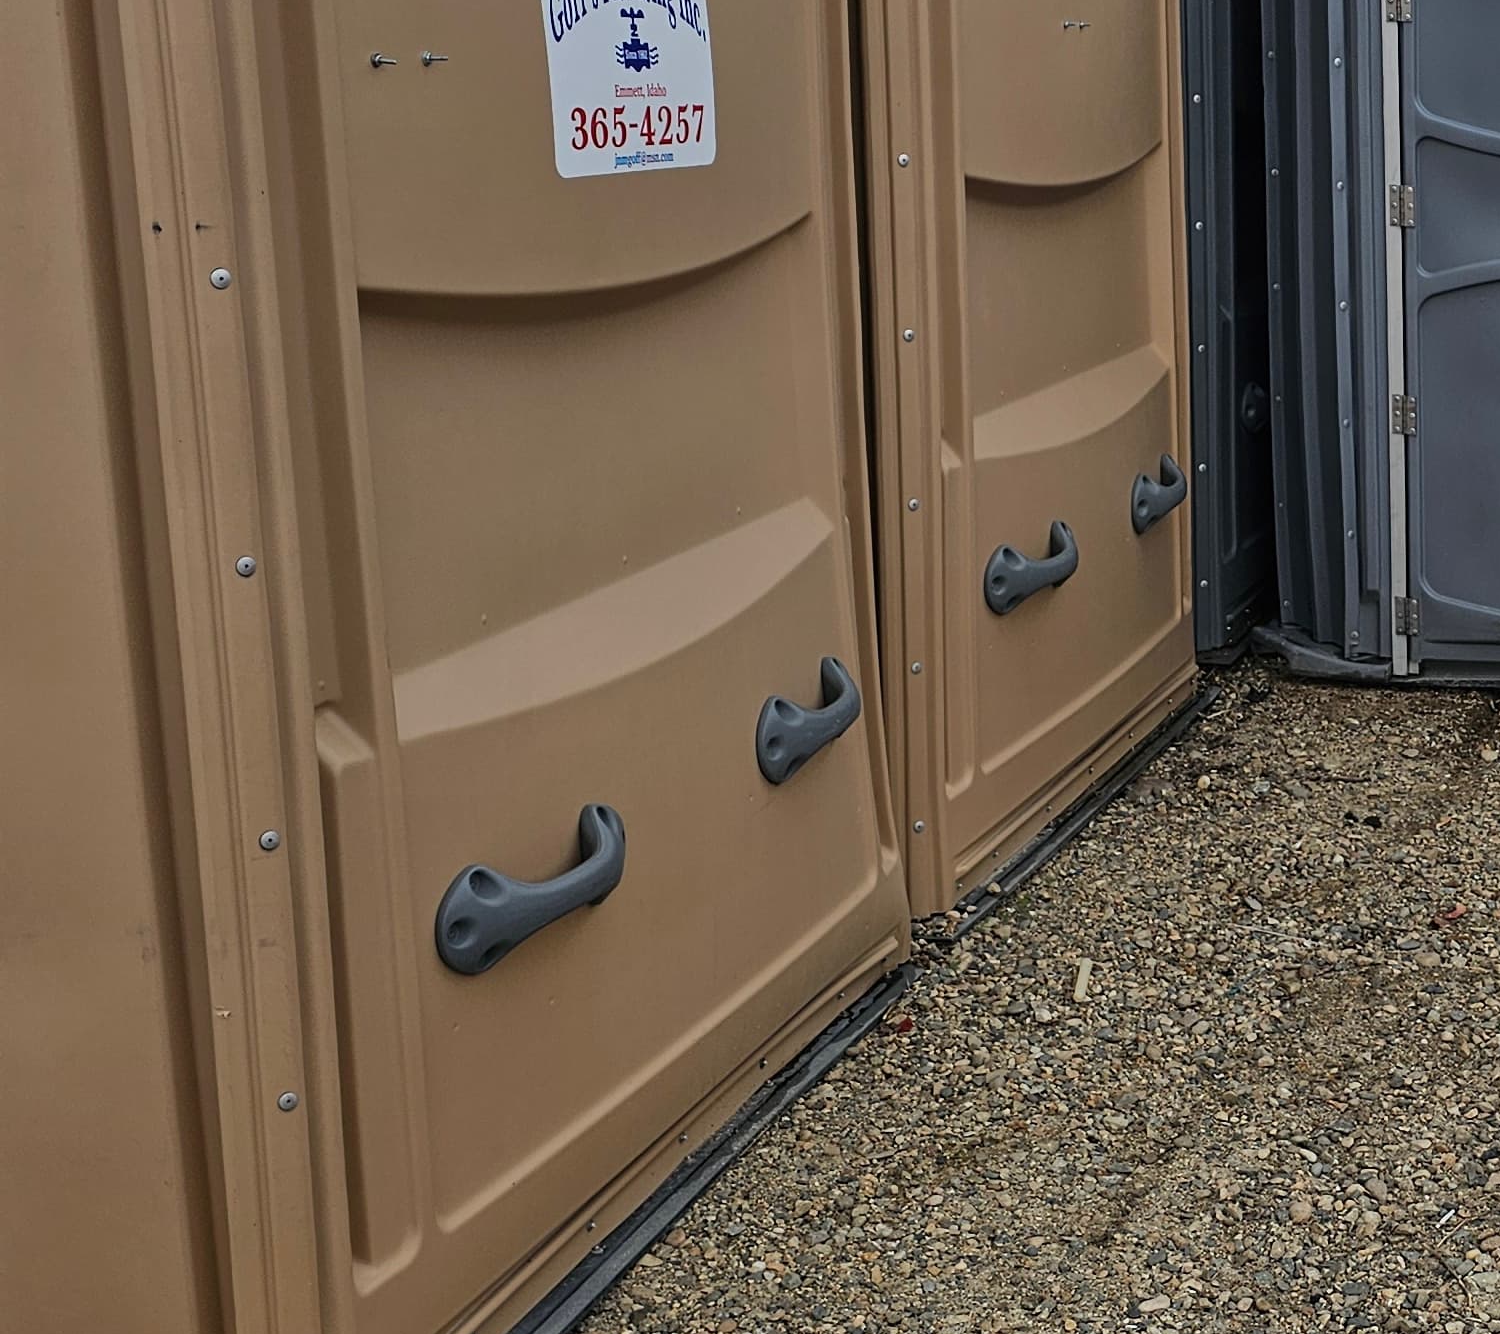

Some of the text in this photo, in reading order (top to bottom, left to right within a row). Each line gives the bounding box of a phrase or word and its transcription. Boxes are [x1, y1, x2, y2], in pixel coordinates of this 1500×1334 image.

[614, 83, 667, 99] Emmett, Idaho
[571, 104, 704, 150] 365-4257
